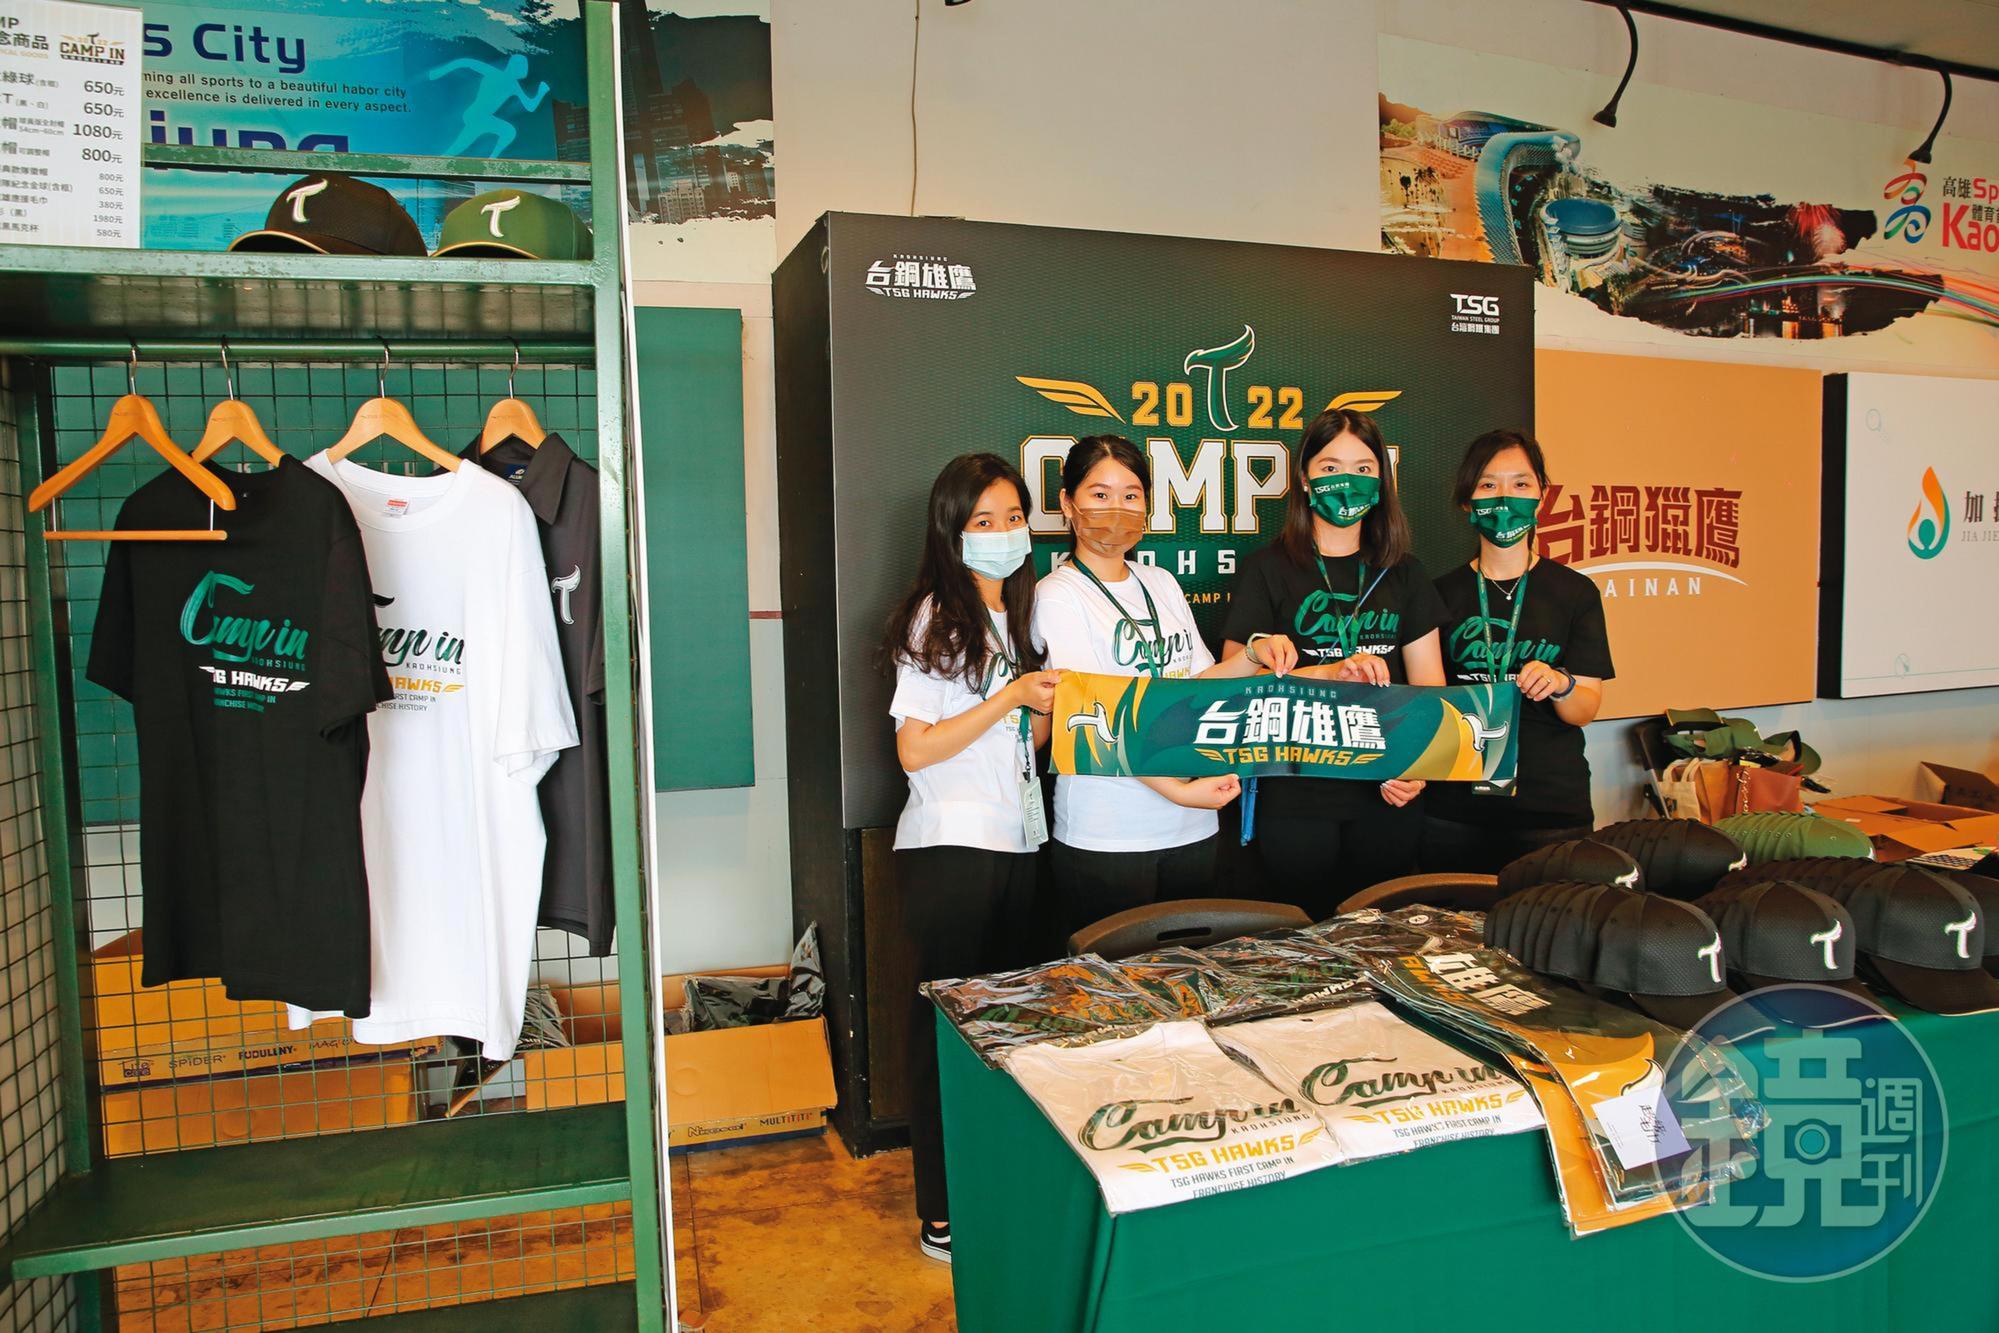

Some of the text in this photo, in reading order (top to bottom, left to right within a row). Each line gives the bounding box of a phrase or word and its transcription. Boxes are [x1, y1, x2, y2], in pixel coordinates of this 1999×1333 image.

[60, 42, 104, 57] CAMP
[109, 48, 125, 60] IN
[193, 23, 306, 74] City
[84, 80, 125, 97] 650元
[180, 74, 196, 84] all
[201, 76, 244, 88] sports
[250, 78, 262, 88] to
[268, 81, 275, 90] a
[280, 80, 338, 93] beautiful
[343, 84, 379, 95] habor
[384, 87, 406, 99] city
[83, 102, 125, 118] 650元
[146, 89, 411, 113] excellence is delivered in every aspect.
[72, 123, 124, 141] 1080元
[81, 148, 123, 164] 800元
[1942, 176, 1972, 199] 高雄
[1971, 204, 1999, 223] 體育
[865, 260, 977, 290] 台鋼雄鷹
[883, 287, 958, 300] TSG HAWKS
[1450, 293, 1500, 316] TSG
[1019, 434, 1290, 536] CMP
[1535, 484, 1743, 570] 台鋼獵鷹
[274, 618, 309, 660] in
[434, 631, 465, 665] in
[1355, 644, 1389, 656] AWKS
[231, 670, 290, 693] HAWKS
[389, 676, 442, 694] AWKS
[1193, 696, 1387, 750] 台鋼雄鷹
[1222, 746, 1354, 766] TSG HAWKS
[1428, 1092, 1504, 1117] HAWKS
[1446, 1119, 1468, 1131] FIRST
[1469, 1117, 1491, 1128] CAMP
[1492, 1114, 1502, 1124] IN
[1151, 1134, 1295, 1174] TSG HAWKS
[1171, 1155, 1295, 1189] TSG HAWKS FIRST CAMP IN
